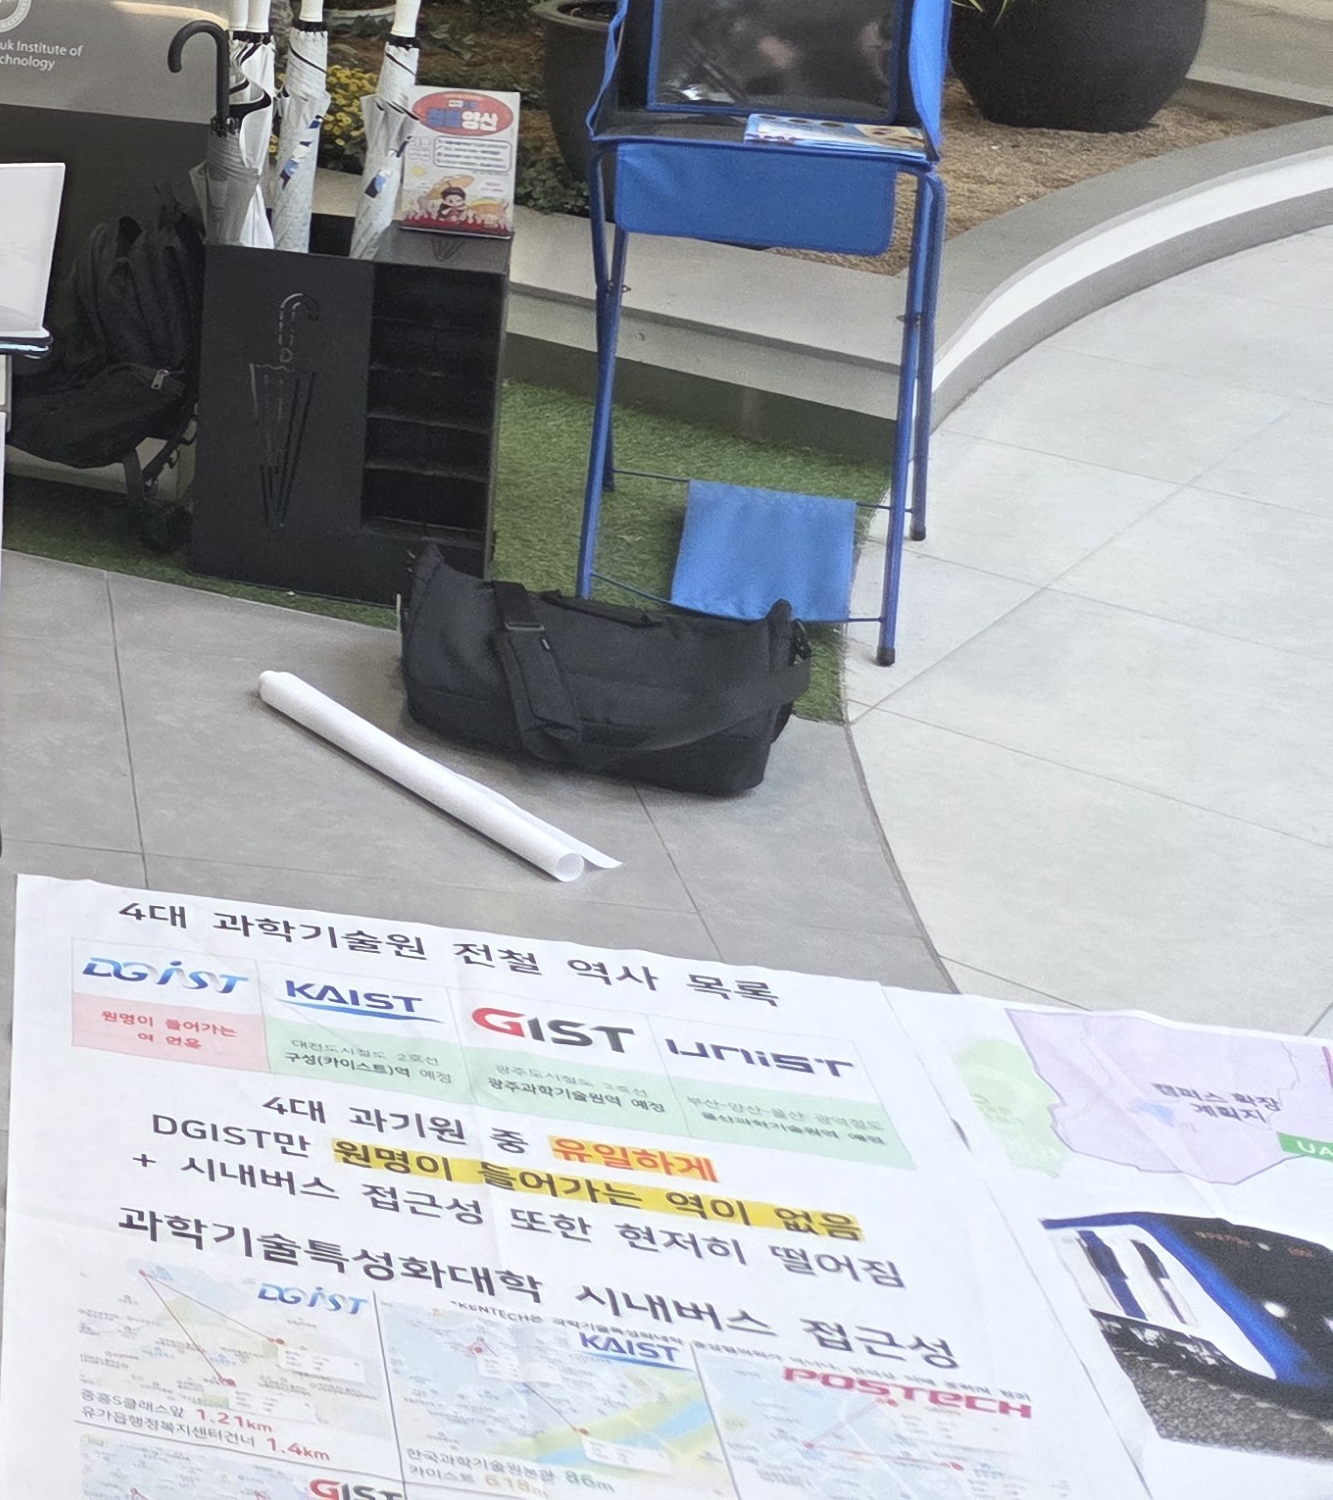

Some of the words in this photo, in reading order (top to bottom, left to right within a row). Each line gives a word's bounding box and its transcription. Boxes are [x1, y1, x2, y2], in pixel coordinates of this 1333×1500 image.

[16, 40, 67, 56] Institute
[69, 44, 84, 57] of
[119, 902, 188, 929] 4대
[213, 911, 428, 960] 과학기술원
[453, 942, 542, 976] 전철
[567, 959, 660, 992] 역사
[686, 974, 780, 1007] 목록
[165, 1017, 238, 1038] 들어가는
[284, 979, 424, 1013] KAIST
[470, 1006, 635, 1054] GIST
[262, 1096, 327, 1125] 4대
[348, 1106, 468, 1147] 과기원
[489, 1126, 530, 1156] 중
[552, 1135, 719, 1183] 유일하게
[151, 1114, 312, 1160] DGIST만
[333, 1137, 454, 1182] 원명이
[476, 1160, 644, 1210] 들어가는
[665, 1189, 753, 1227] 역이
[773, 1205, 864, 1242] 없음
[180, 1156, 341, 1201] 시내버스
[361, 1183, 486, 1227] 접근성
[510, 1207, 593, 1244] 또한
[614, 1221, 749, 1267] 현저히
[768, 1243, 908, 1290] 떨어짐
[118, 1205, 544, 1305] 과학기술특성화대학
[575, 1284, 778, 1338] 시내버스
[800, 1316, 962, 1371] 접근성
[579, 1331, 681, 1363] KAIST
[196, 1407, 274, 1434] 1.21km
[267, 1436, 331, 1462] 1.4km
